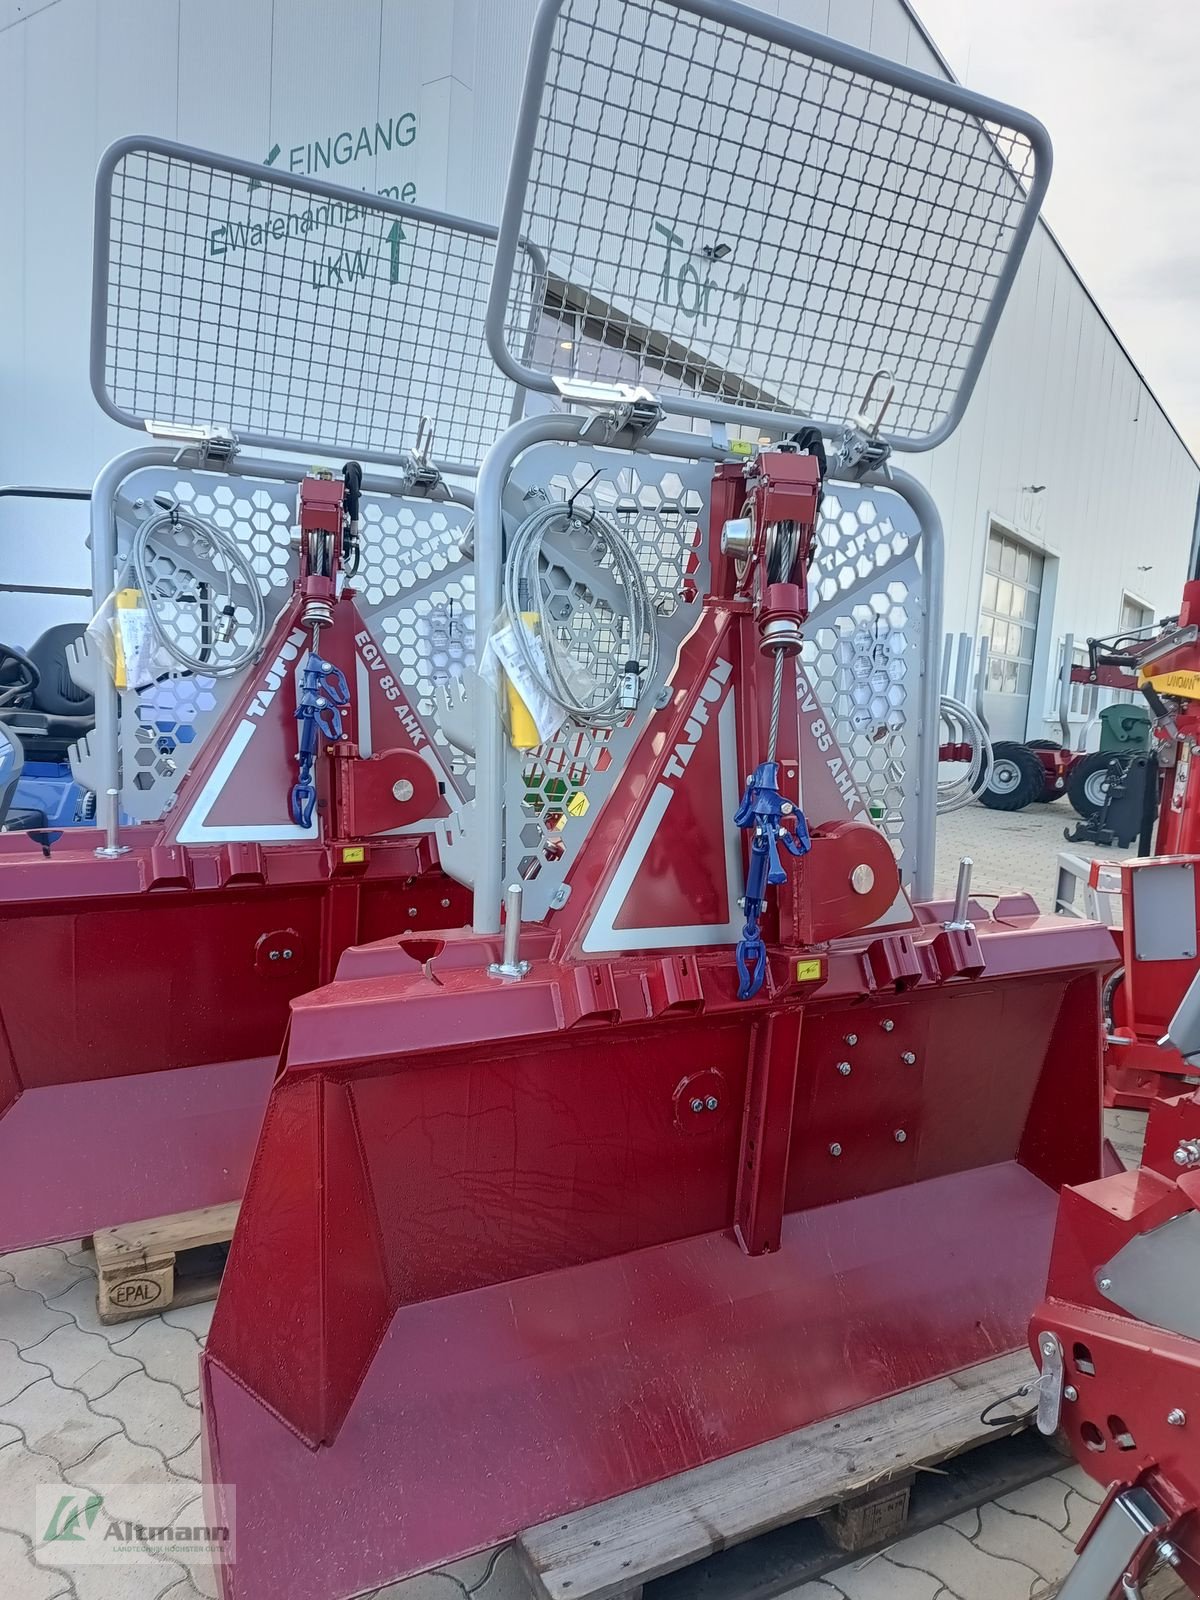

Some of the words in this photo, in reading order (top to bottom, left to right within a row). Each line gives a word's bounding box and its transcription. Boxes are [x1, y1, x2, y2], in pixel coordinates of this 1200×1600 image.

[290, 112, 417, 175] EINGANG
[312, 247, 371, 290] LKW
[655, 221, 718, 327] Tor
[733, 283, 746, 339] 1
[398, 525, 463, 565] TAJFUN
[820, 517, 894, 571] TAJFUN
[246, 627, 308, 717] TAJFUN
[354, 630, 386, 672] EGV
[379, 675, 401, 701] 85
[394, 704, 427, 746] AHK
[662, 656, 734, 781] TAJFUN
[810, 718, 834, 752] 85
[826, 757, 861, 812] AHK
[116, 1284, 153, 1303] EPAL
